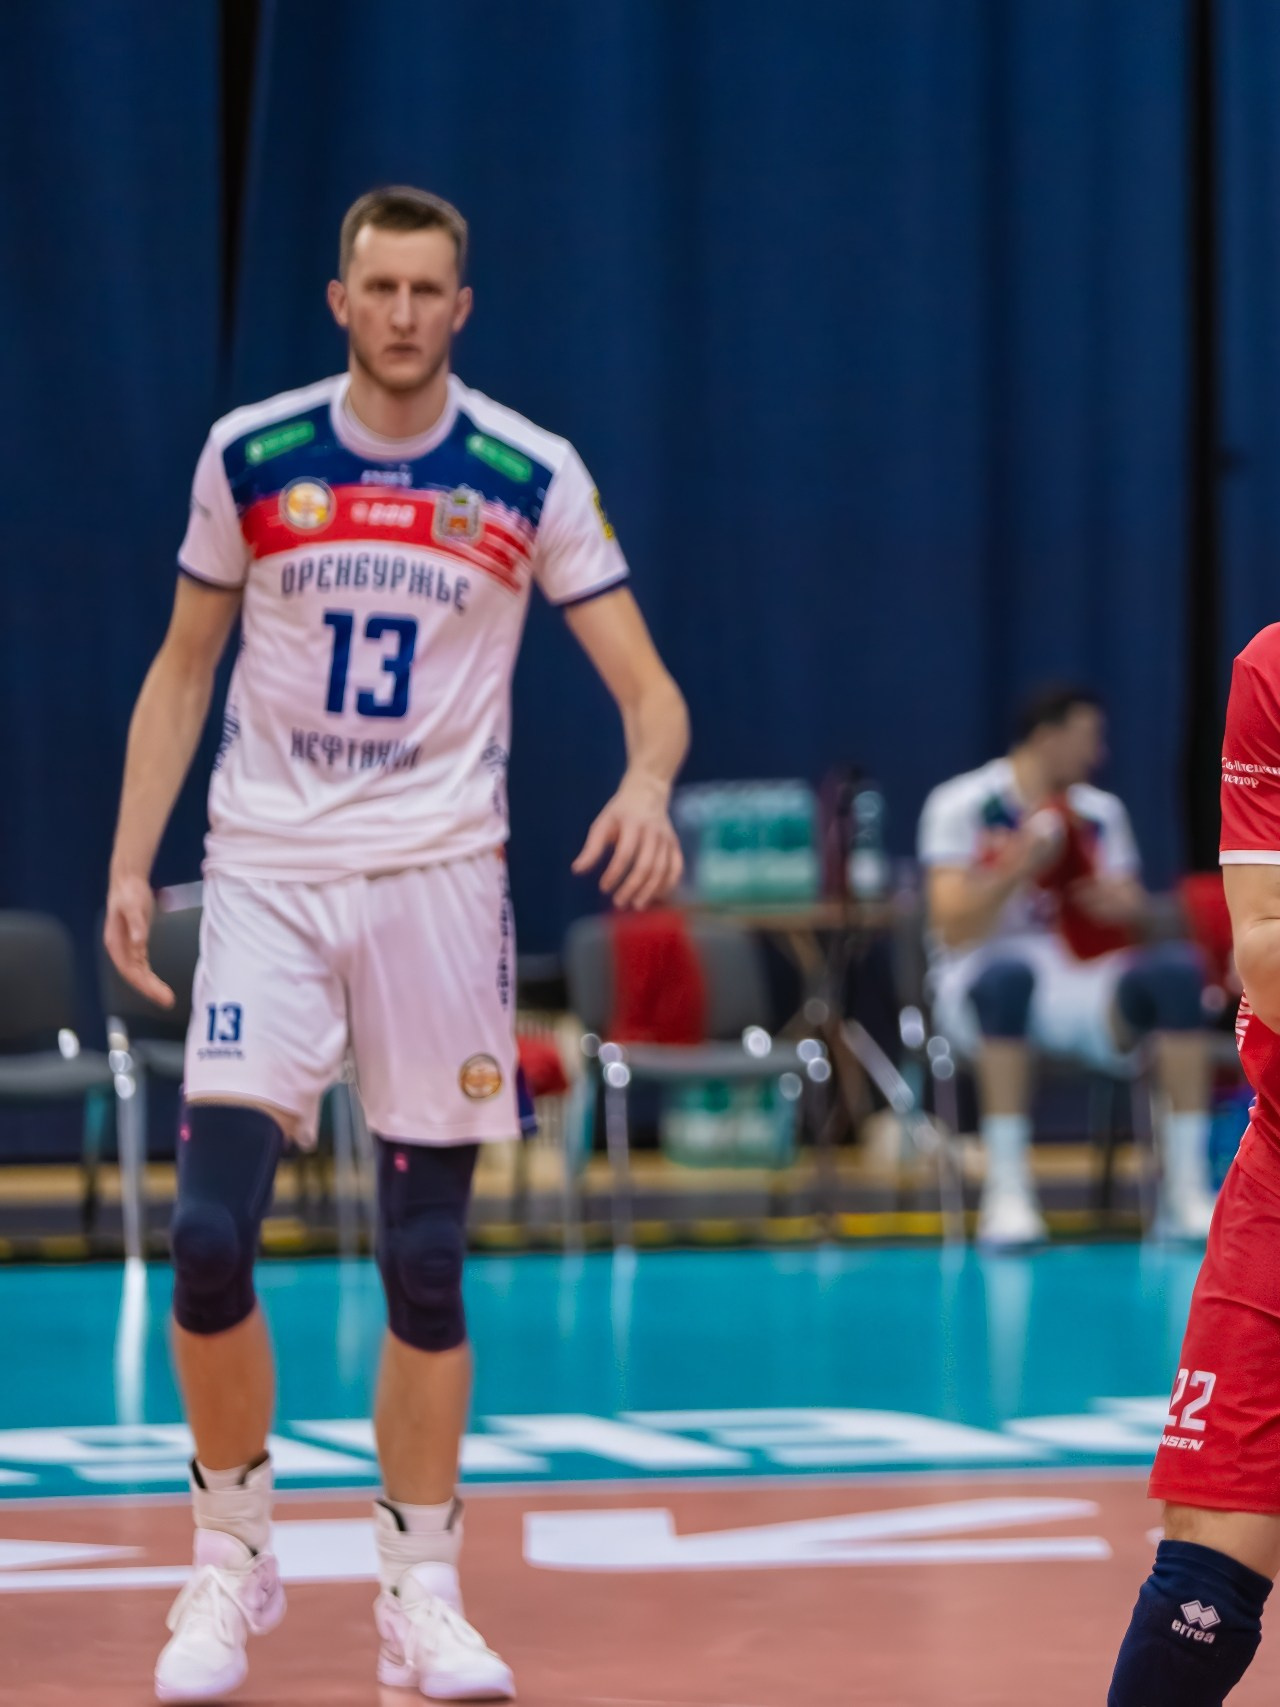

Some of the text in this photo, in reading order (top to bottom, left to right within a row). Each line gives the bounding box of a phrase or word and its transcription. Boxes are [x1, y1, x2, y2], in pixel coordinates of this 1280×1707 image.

[281, 553, 471, 616] ОРЕНБУРЖЬЕ
[322, 609, 418, 718] 13
[206, 1002, 242, 1044] 13
[1160, 1434, 1204, 1452] NSEN
[1171, 1619, 1215, 1644] errea
